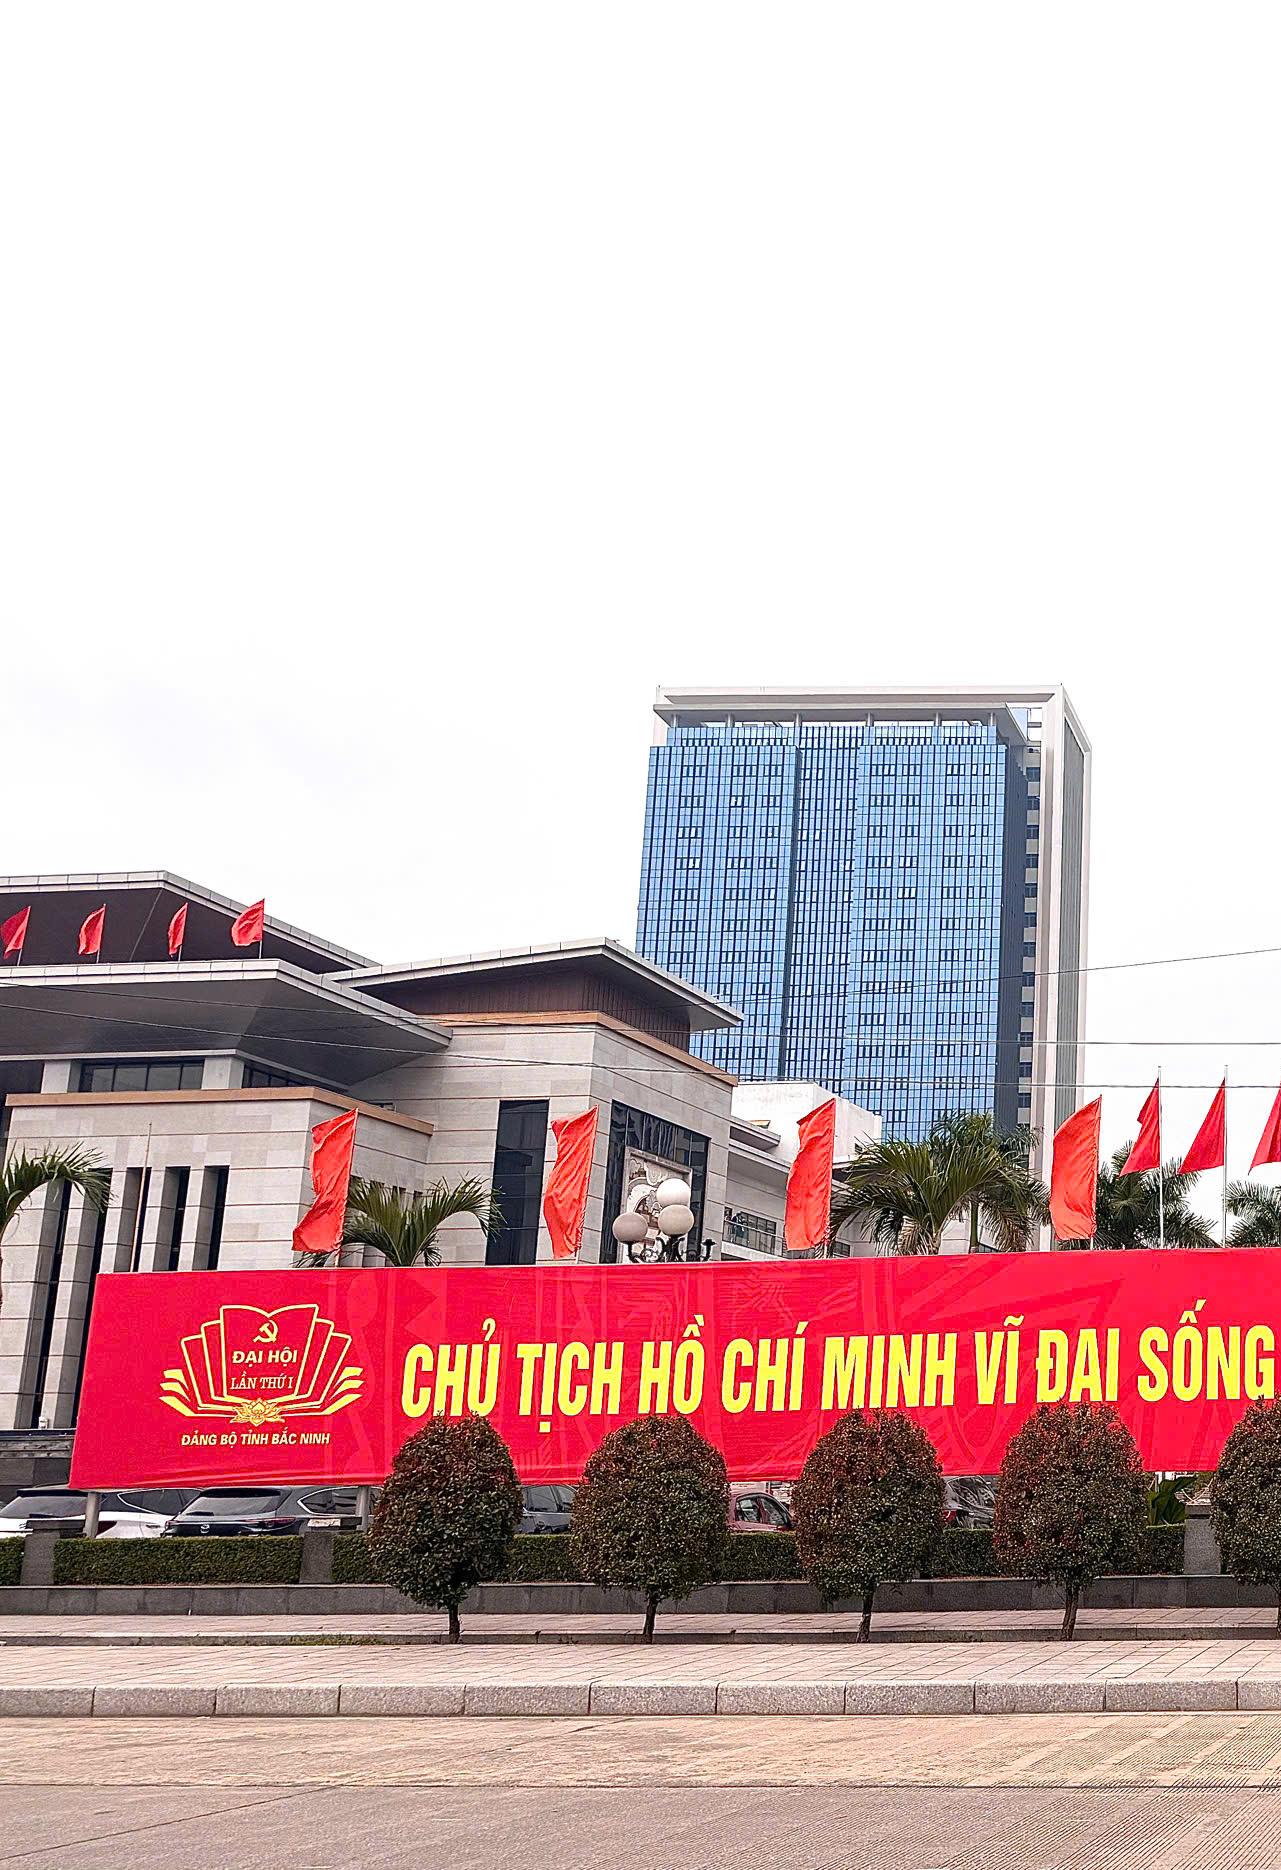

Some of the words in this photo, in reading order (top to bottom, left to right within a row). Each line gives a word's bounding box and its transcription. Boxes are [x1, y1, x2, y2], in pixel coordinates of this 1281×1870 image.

[232, 1350, 264, 1367] ĐẠI
[267, 1346, 298, 1367] HỘI
[401, 1317, 500, 1416] CHỦ
[516, 1341, 624, 1433] TỊCH
[637, 1314, 705, 1414] HỒ
[721, 1321, 809, 1413] CHÍ
[820, 1332, 957, 1410] MINH
[974, 1314, 1025, 1404] VĨ
[1137, 1299, 1275, 1401] SỐNG
[230, 1370, 257, 1390] LẦN
[260, 1373, 287, 1389] THỨ
[287, 1376, 294, 1389] I
[181, 1430, 217, 1446] ĐẢNG
[220, 1431, 238, 1448] BỘ
[240, 1429, 269, 1445] TỈNH
[271, 1427, 297, 1445] BẮC
[299, 1433, 331, 1445] NINH
